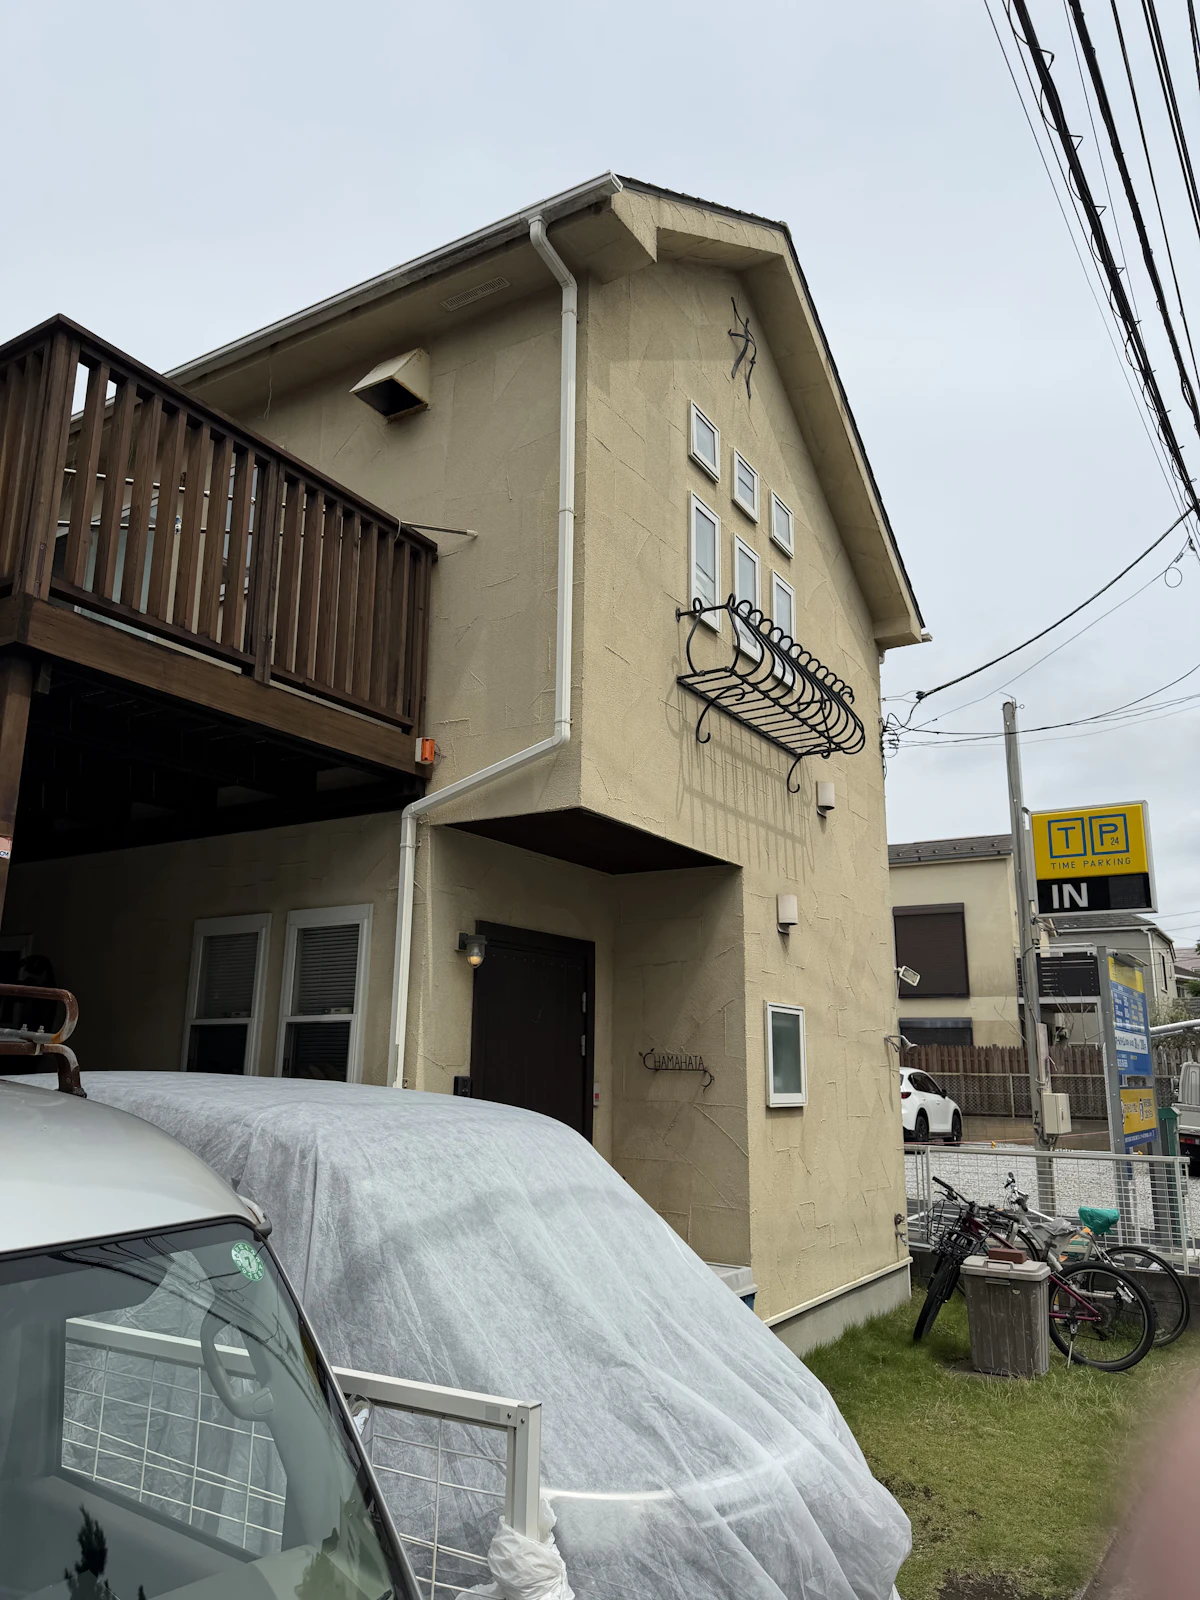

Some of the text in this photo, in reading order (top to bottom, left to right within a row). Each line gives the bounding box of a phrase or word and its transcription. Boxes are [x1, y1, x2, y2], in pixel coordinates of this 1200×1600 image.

[1110, 837, 1119, 846] 24
[1050, 857, 1131, 870] TIME PARKING
[1051, 882, 1089, 910] IN
[244, 1256, 252, 1269] 7
